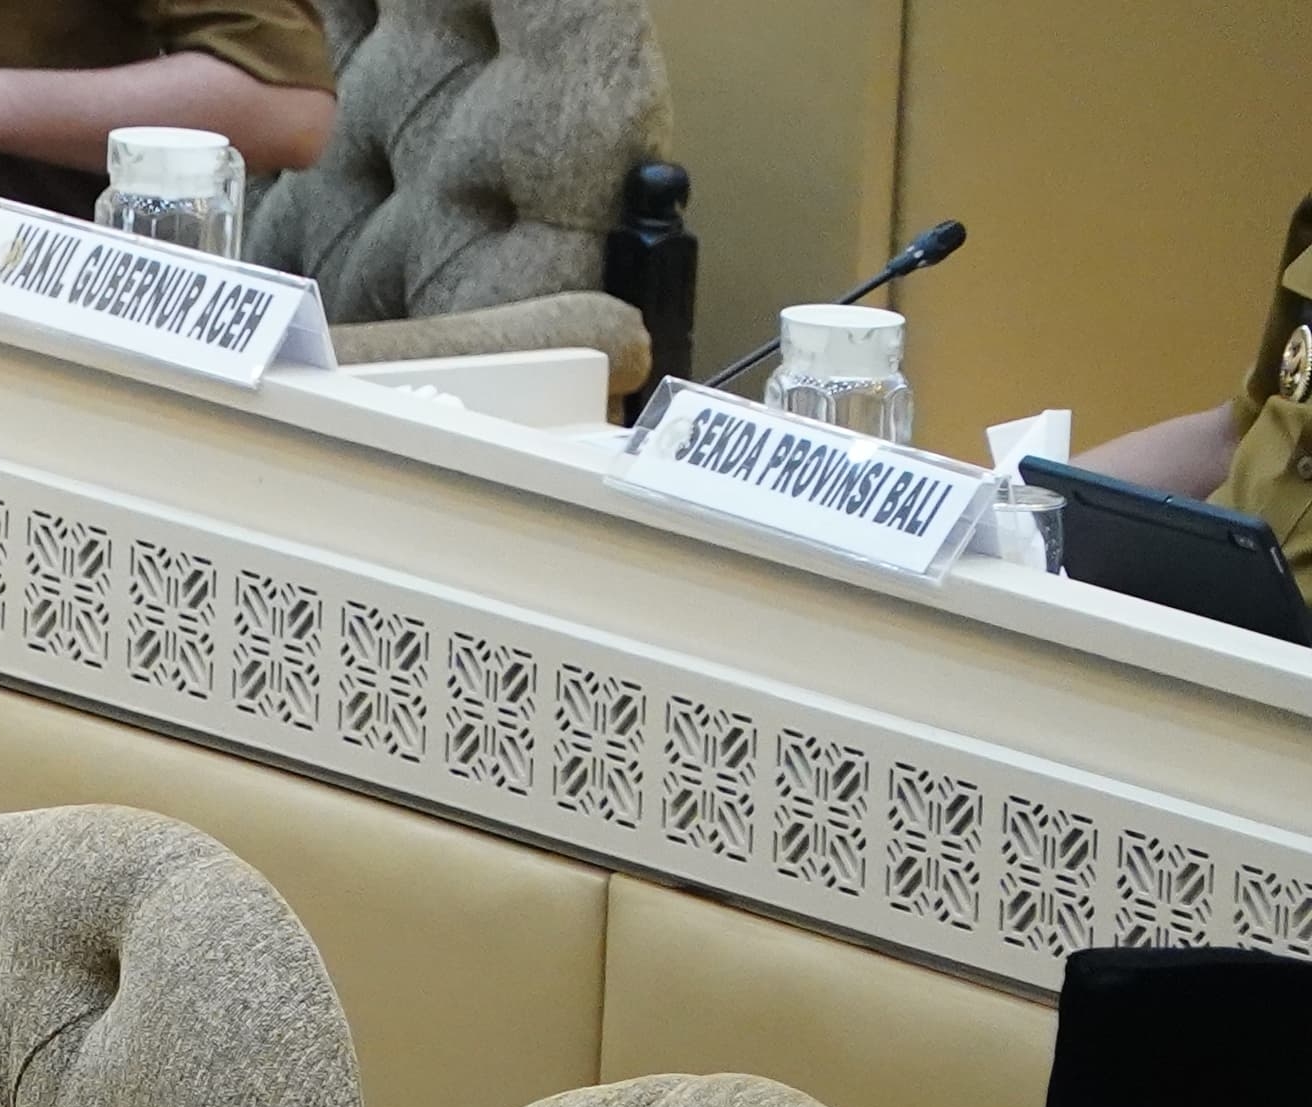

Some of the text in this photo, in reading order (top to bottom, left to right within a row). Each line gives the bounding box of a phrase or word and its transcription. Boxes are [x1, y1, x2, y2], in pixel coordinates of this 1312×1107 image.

[67, 243, 208, 335] GUBERNUR
[187, 280, 275, 353] ACEH
[675, 407, 953, 538] SEKDA PROVINSI BALI
